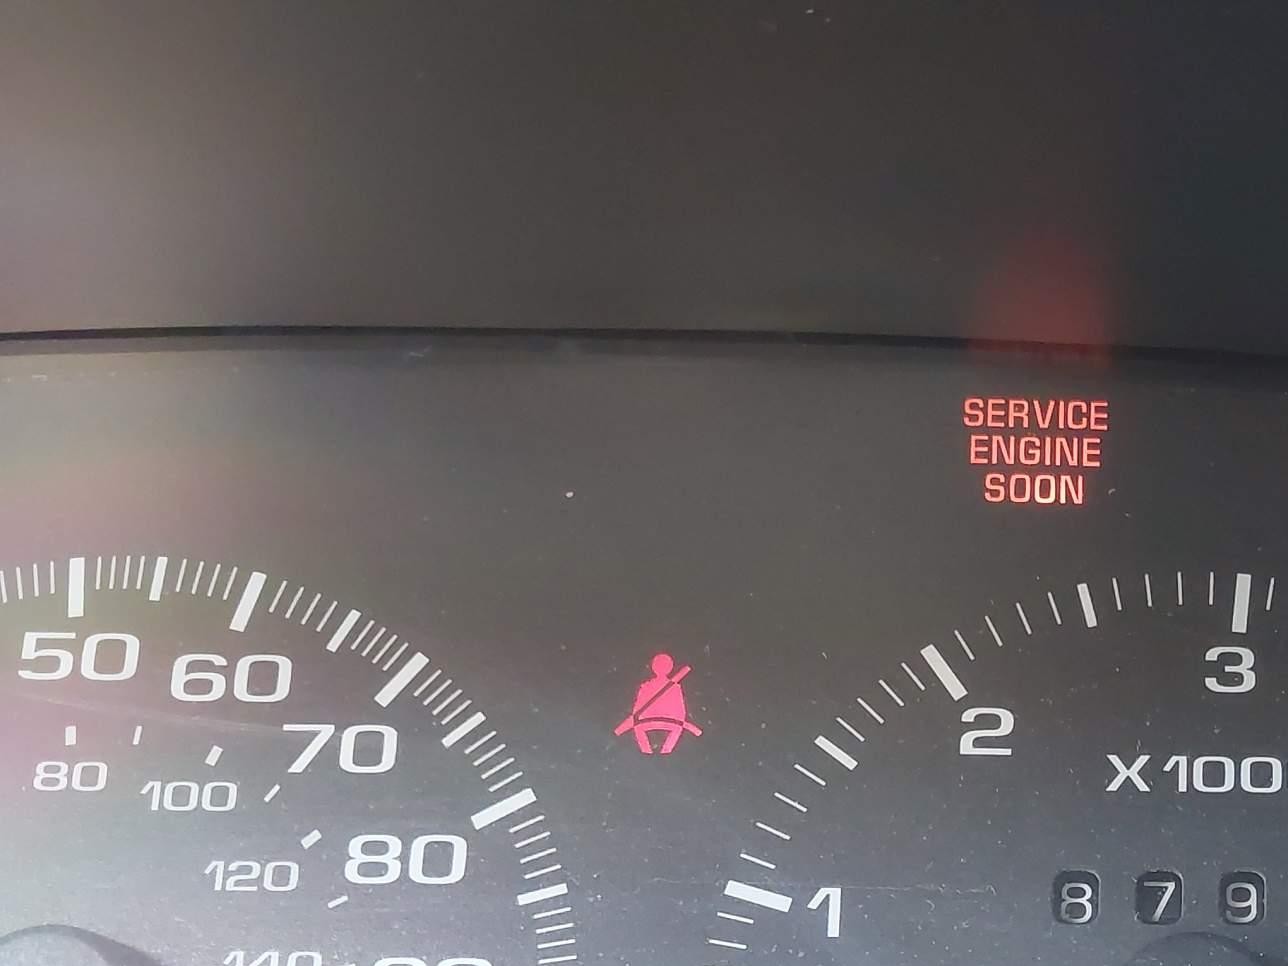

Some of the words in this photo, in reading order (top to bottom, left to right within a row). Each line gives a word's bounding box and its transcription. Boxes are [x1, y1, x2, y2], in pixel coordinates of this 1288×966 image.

[963, 398, 1109, 431] SERVICE
[968, 435, 1102, 468] ENGINE
[983, 473, 1084, 506] SOON
[17, 632, 140, 681] 50
[170, 654, 294, 702] 60
[1204, 647, 1257, 694] 3
[282, 724, 398, 774] 70
[959, 707, 1015, 756] 2
[32, 762, 108, 792] 80
[140, 781, 238, 812] 100
[203, 860, 299, 892] 120
[344, 834, 467, 885] 80
[806, 887, 842, 938] 1
